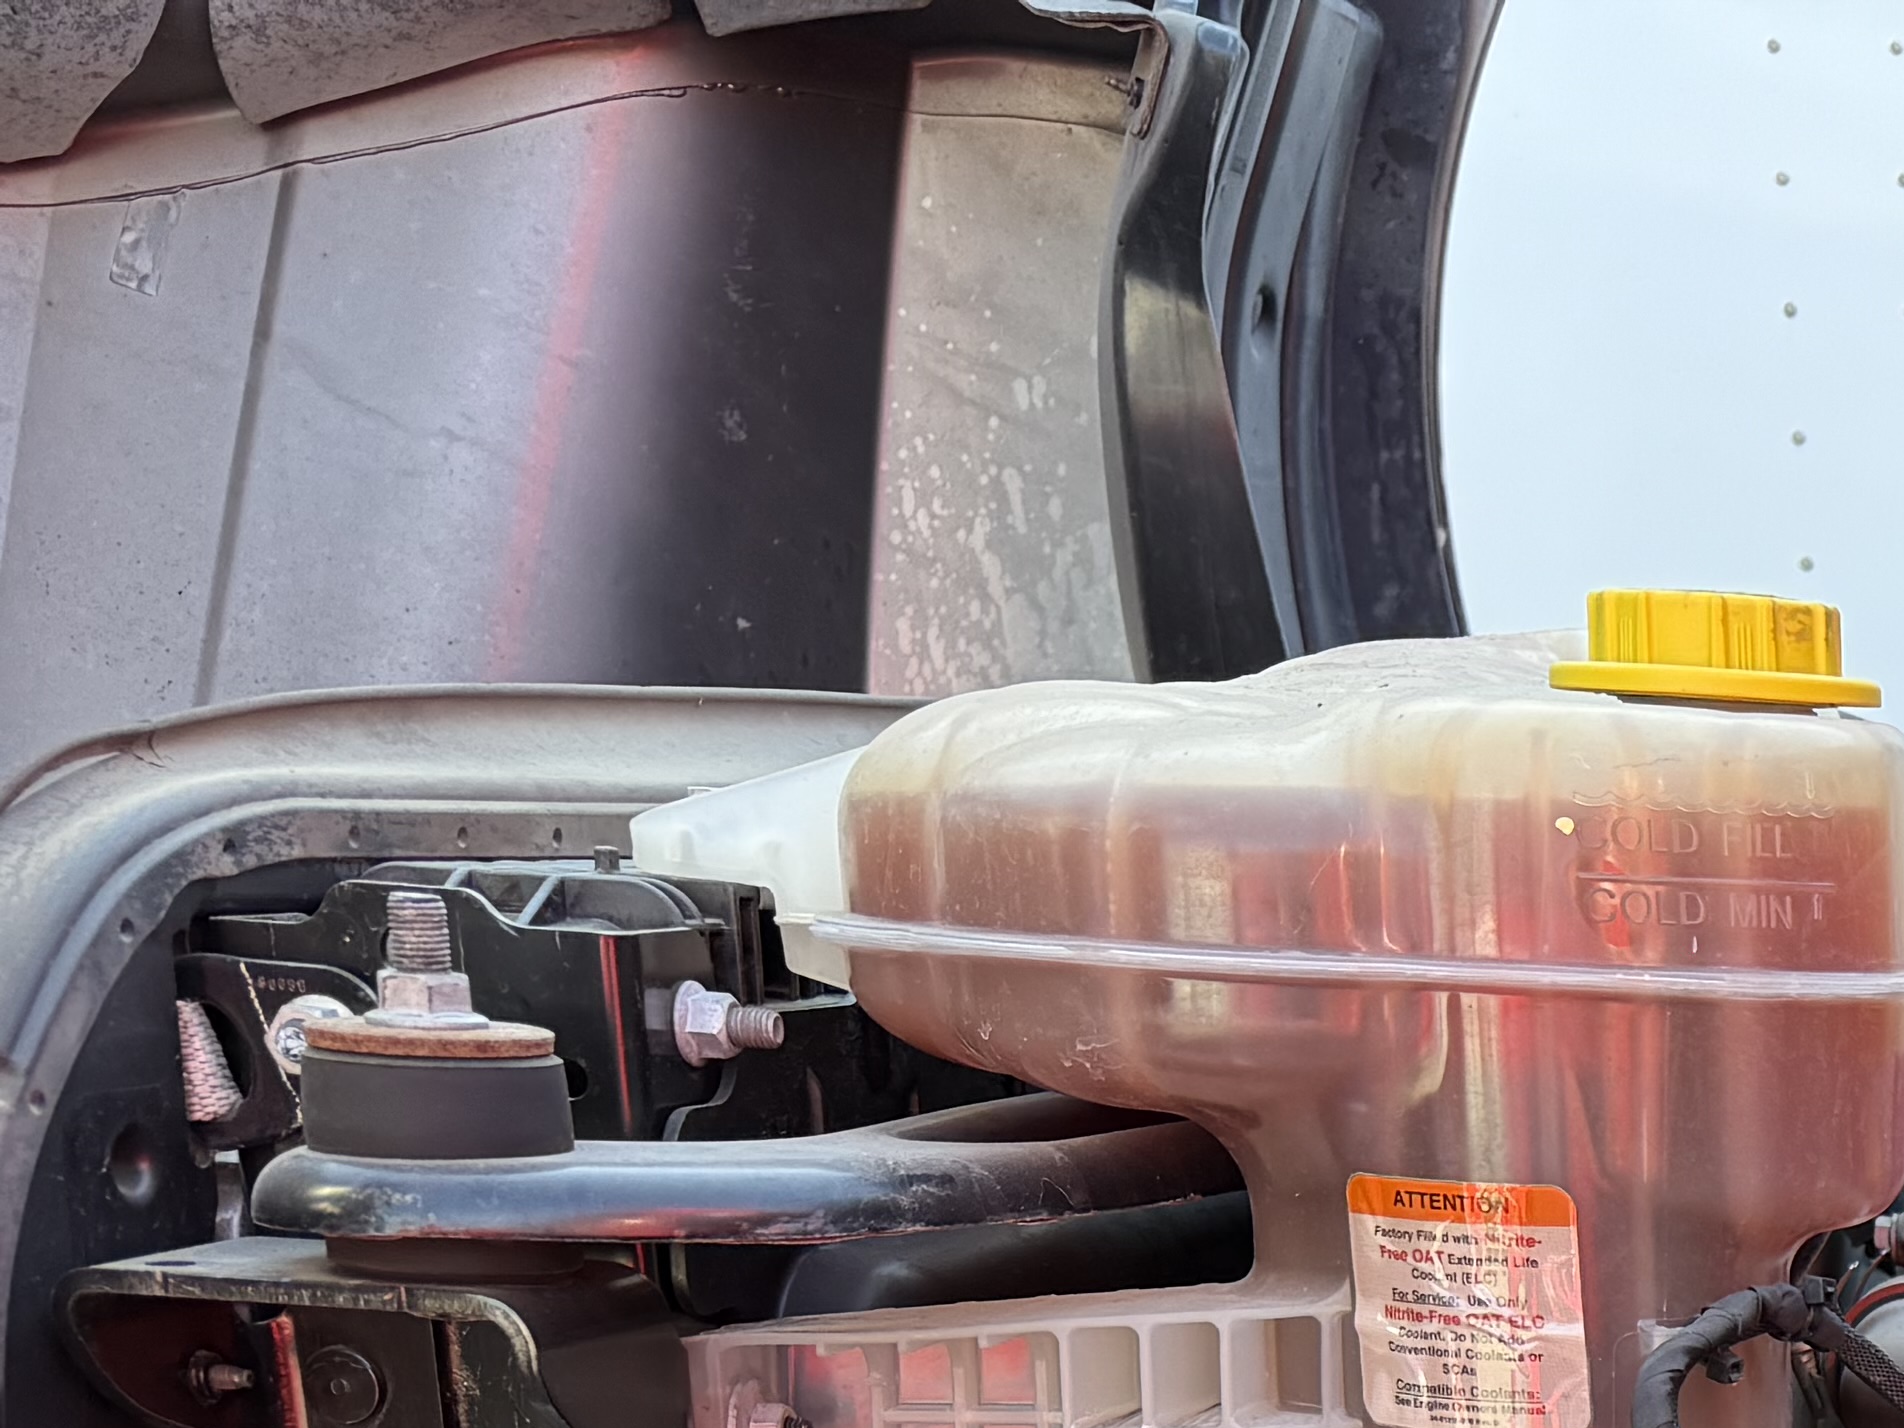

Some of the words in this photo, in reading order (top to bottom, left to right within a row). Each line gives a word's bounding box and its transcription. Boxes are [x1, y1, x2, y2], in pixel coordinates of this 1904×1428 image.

[1574, 814, 1698, 857] COLD
[1720, 820, 1794, 858] FILL
[1586, 887, 1706, 928] COLD
[1730, 892, 1793, 930] MIN
[1393, 1190, 1509, 1214] ATTENTION
[1374, 1226, 1414, 1242] Factory
[1452, 1232, 1478, 1245] with
[1380, 1245, 1407, 1260] Free
[1412, 1248, 1444, 1265] OAT
[1447, 1253, 1508, 1268] Extended
[1513, 1256, 1539, 1269] Life
[1392, 1288, 1409, 1303] For
[1497, 1296, 1528, 1310] Only
[1384, 1305, 1461, 1326] Nitrite-Free
[1509, 1313, 1545, 1329] ELC
[1388, 1340, 1461, 1359] Conventional
[1529, 1352, 1544, 1363] or
[1442, 1363, 1477, 1377] SCAs
[1395, 1396, 1412, 1408] See
